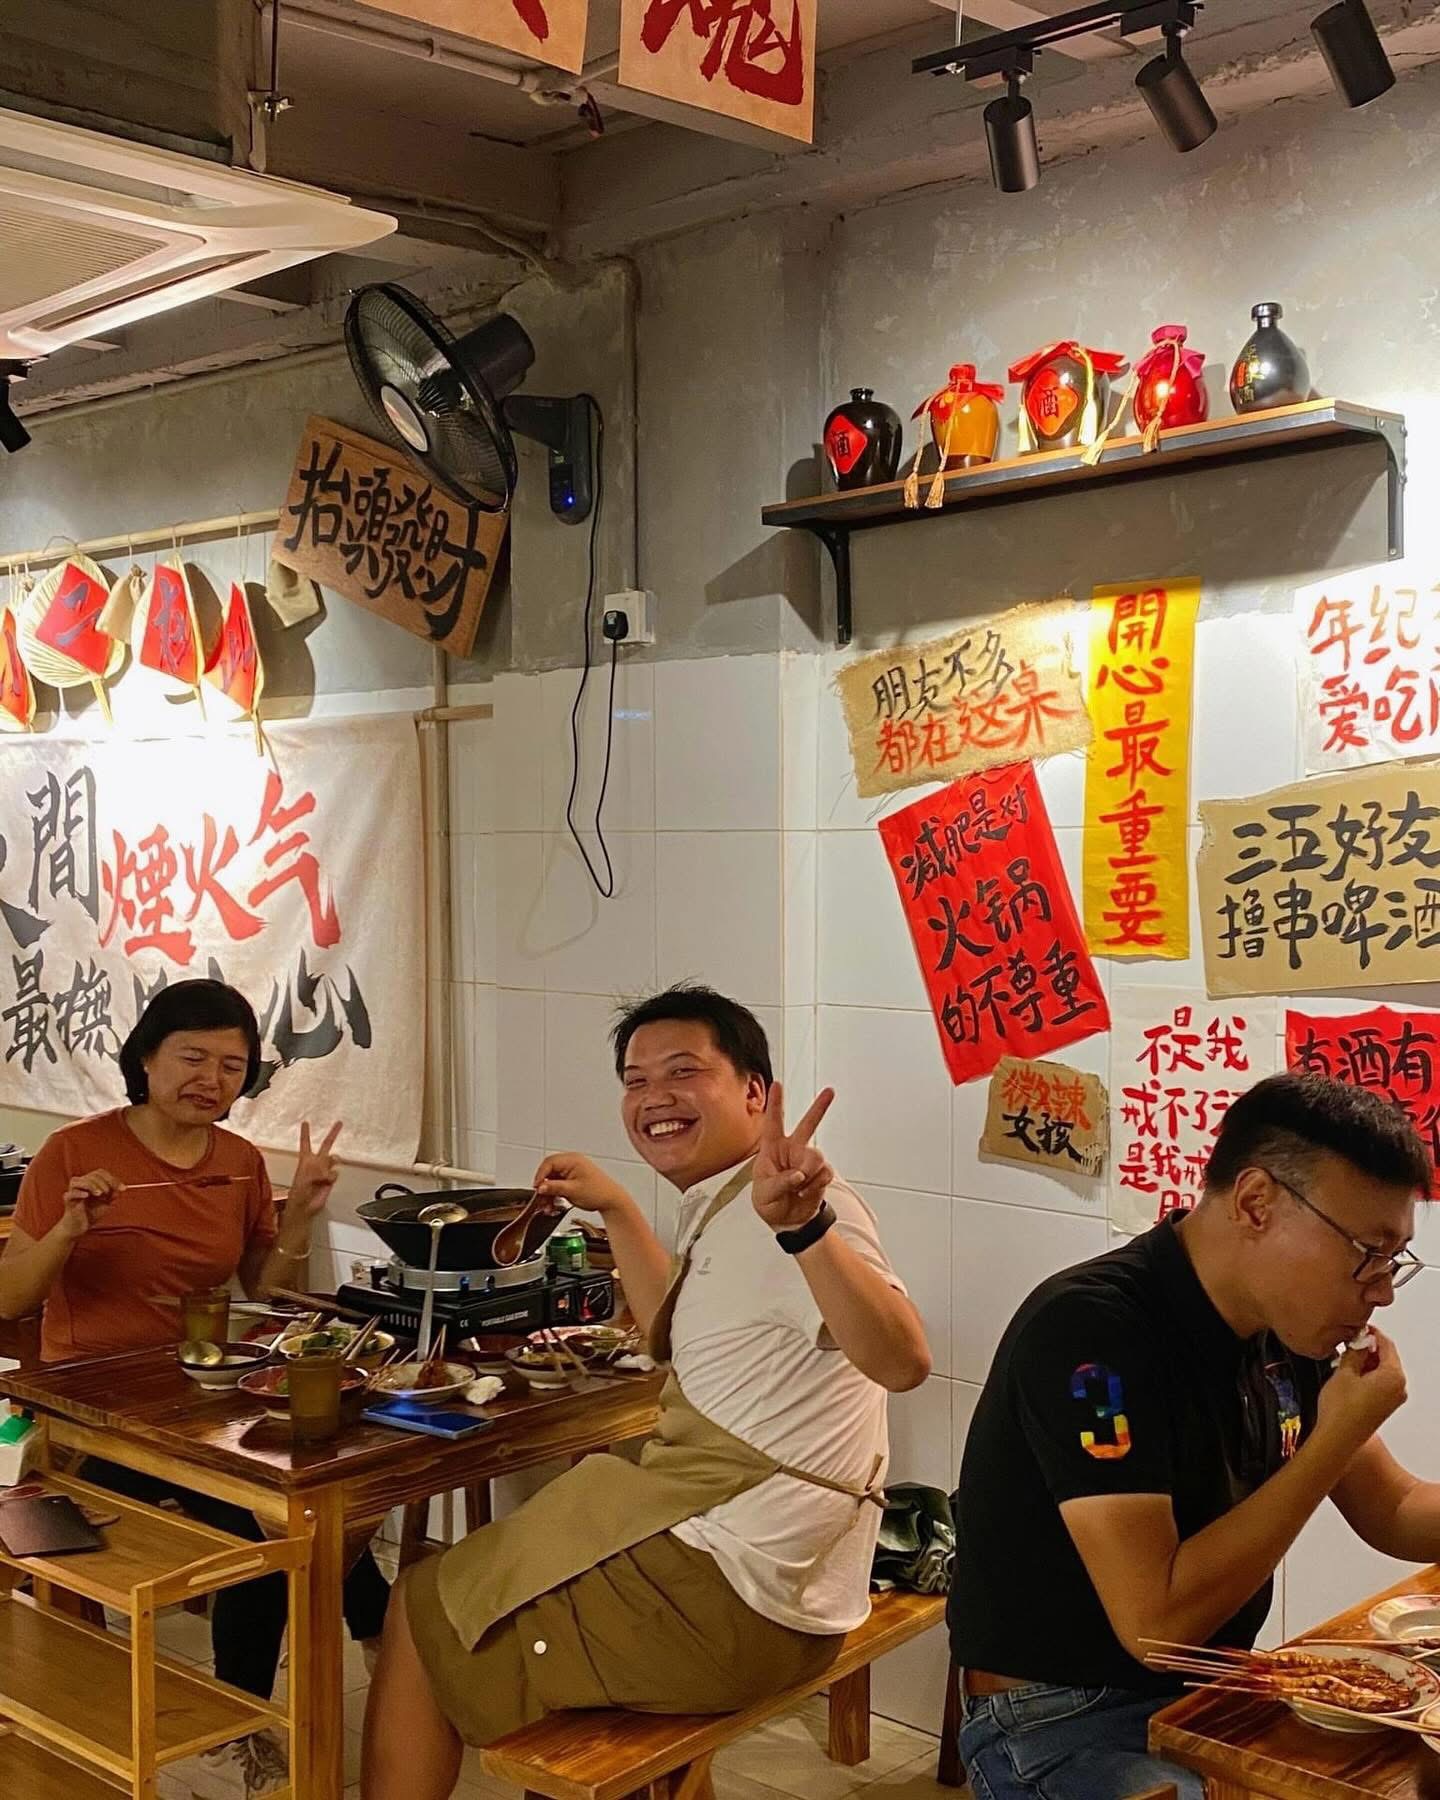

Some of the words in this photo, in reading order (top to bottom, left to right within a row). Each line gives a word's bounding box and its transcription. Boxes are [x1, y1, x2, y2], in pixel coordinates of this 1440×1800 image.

[832, 431, 849, 457] 酒
[1039, 386, 1058, 419] 酒
[284, 440, 487, 640] 抬頭發財
[1308, 584, 1440, 671] 年纪
[873, 630, 1015, 721] 朋友不多
[873, 658, 1080, 777] 都在这桌
[1319, 664, 1440, 753] 爱吃
[1095, 586, 1176, 947] 開心最重要
[1224, 791, 1440, 884] 三五好友
[927, 858, 1052, 972] 火锅
[1216, 877, 1440, 970] 撸串啤酒
[1, 947, 372, 1098] 最撫心
[941, 940, 1097, 1044] 的不尊重
[1136, 1006, 1249, 1075] 不是我
[1292, 1021, 1436, 1094] 有酒有
[1002, 1104, 1082, 1164] 女孩
